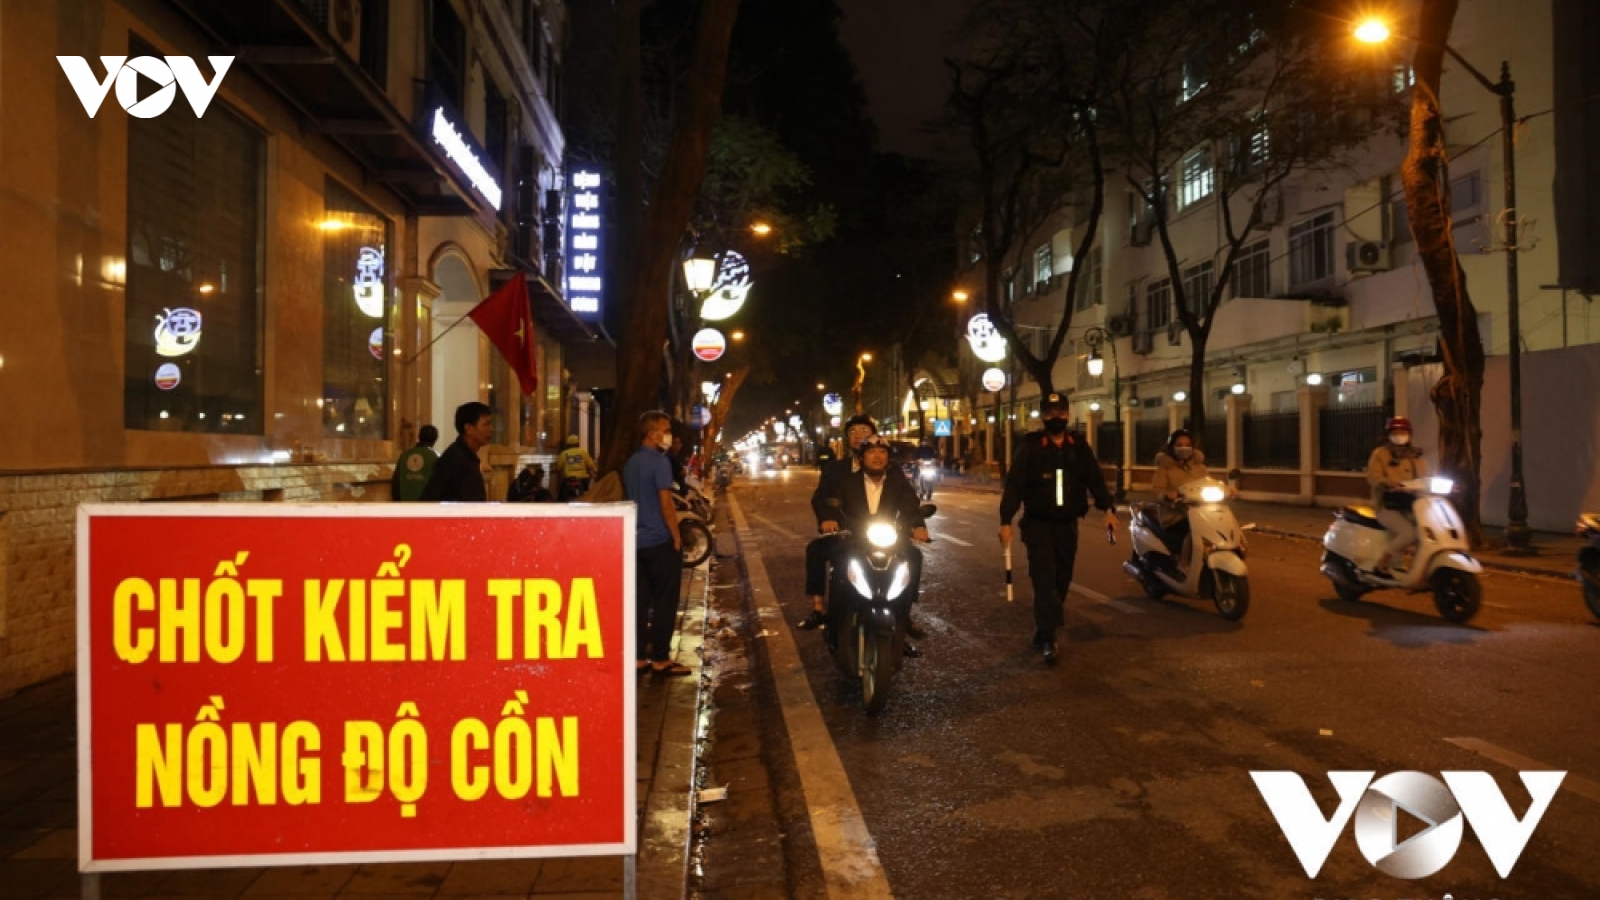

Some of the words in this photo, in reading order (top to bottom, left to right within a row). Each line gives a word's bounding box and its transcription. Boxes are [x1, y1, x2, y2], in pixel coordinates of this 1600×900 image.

[113, 551, 283, 664] CHỐT
[304, 543, 466, 662] KIỂM
[487, 577, 604, 660] TRA
[136, 696, 321, 808] NỒNG
[342, 701, 428, 817] ĐỘ
[451, 690, 579, 801] CỒN
